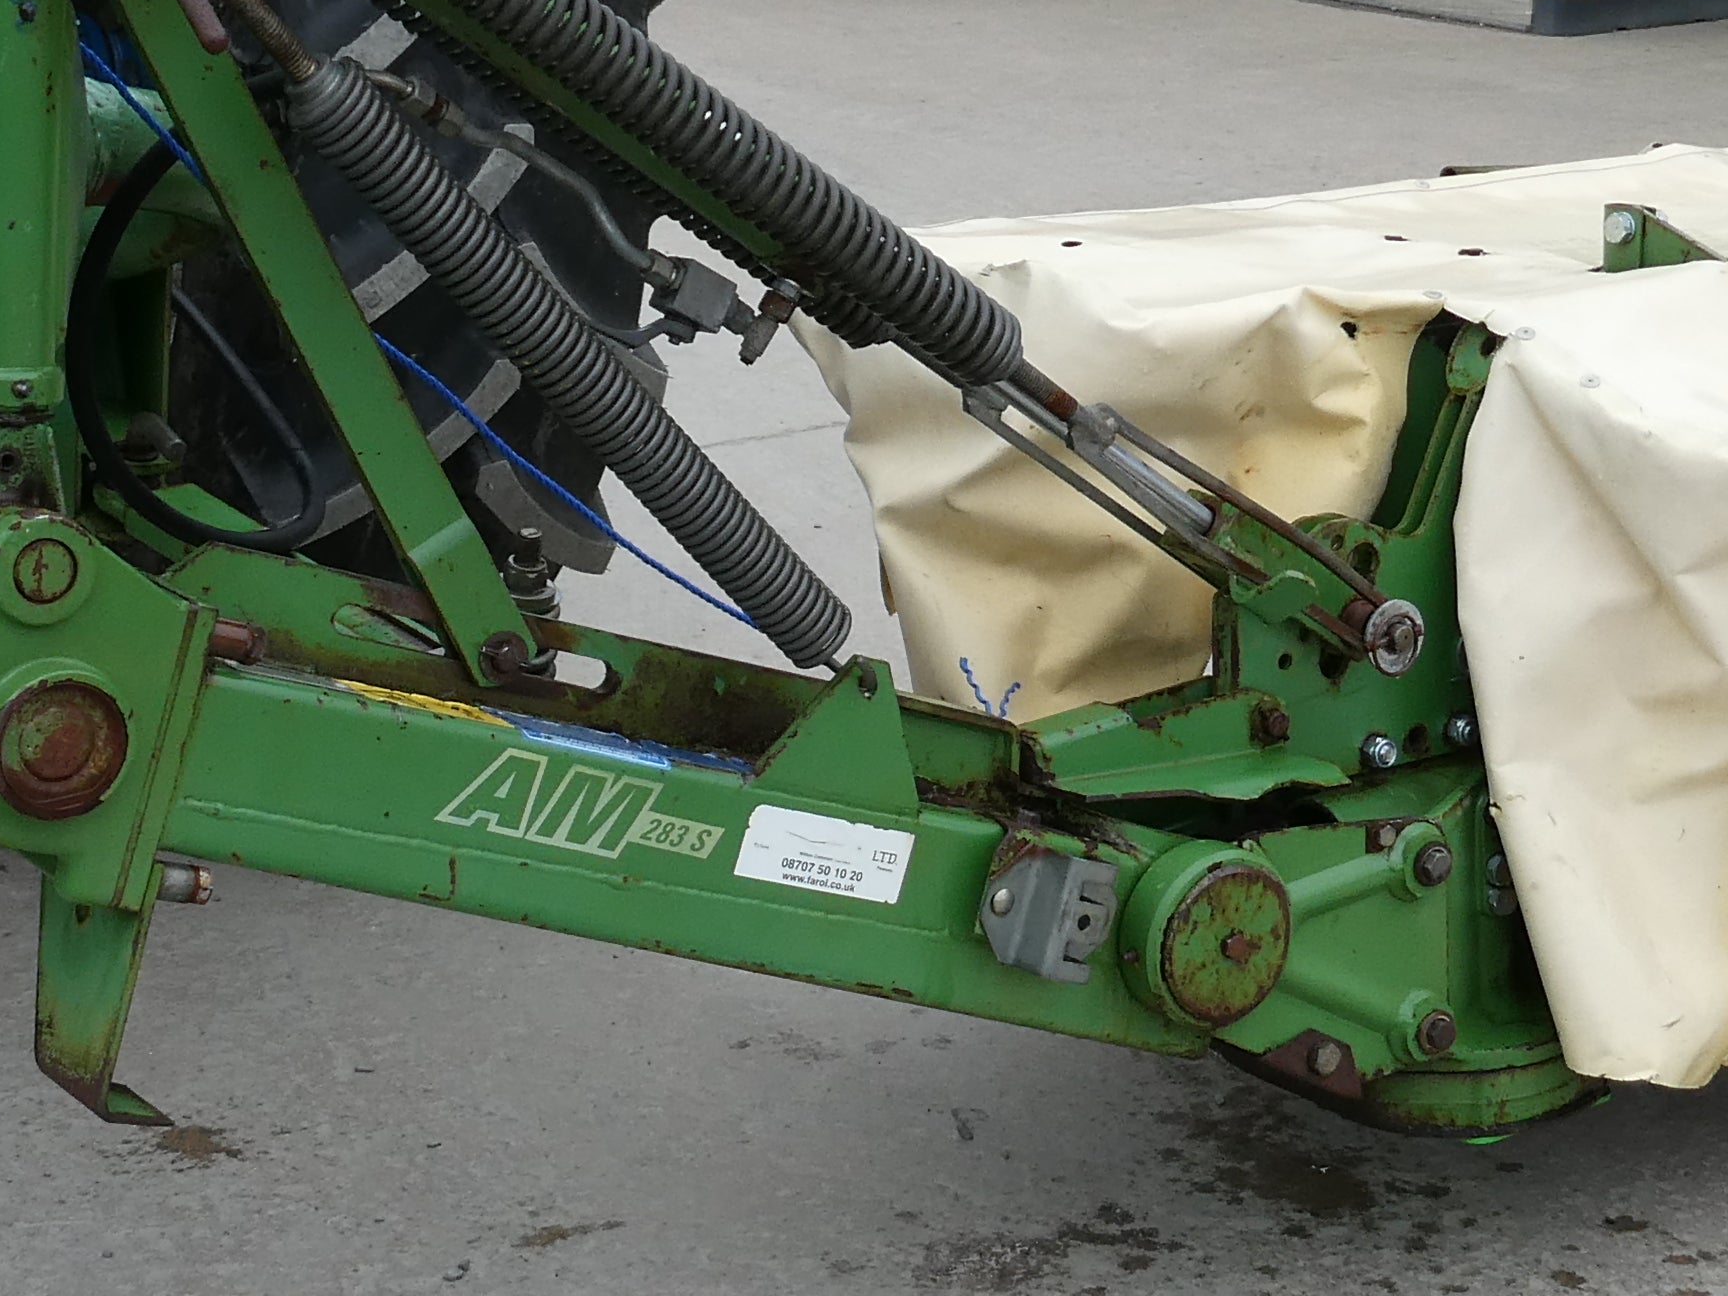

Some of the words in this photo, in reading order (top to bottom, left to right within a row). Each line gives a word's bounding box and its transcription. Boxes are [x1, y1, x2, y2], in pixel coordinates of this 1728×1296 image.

[434, 747, 664, 859] AM
[639, 818, 690, 848] 283
[690, 828, 713, 853] S
[781, 857, 815, 873] 08707
[817, 865, 831, 876] 50
[835, 867, 847, 878] 10
[849, 870, 863, 882] 20
